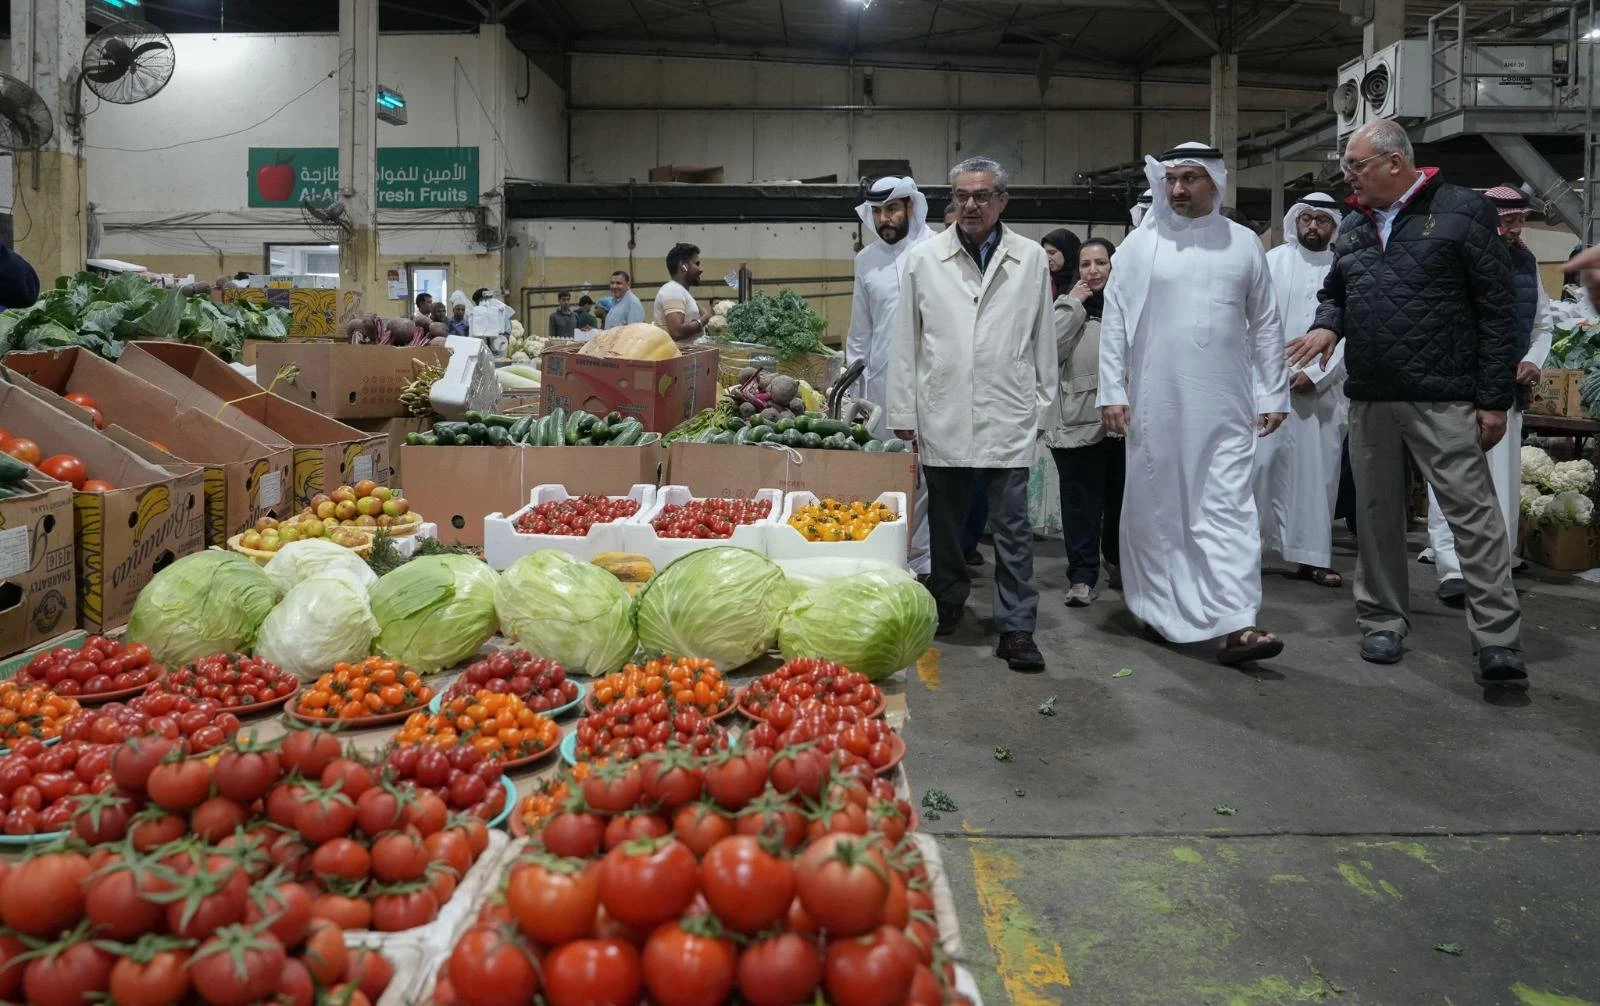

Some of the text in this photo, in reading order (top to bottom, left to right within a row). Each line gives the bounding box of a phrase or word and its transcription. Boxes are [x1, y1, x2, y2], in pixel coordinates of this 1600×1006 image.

[300, 162, 466, 185] الأمين للفوا طازجة
[376, 188, 415, 202] resh
[420, 187, 467, 202] Fruits
[112, 492, 195, 588] Bananas
[29, 569, 72, 596] SHARBATLY
